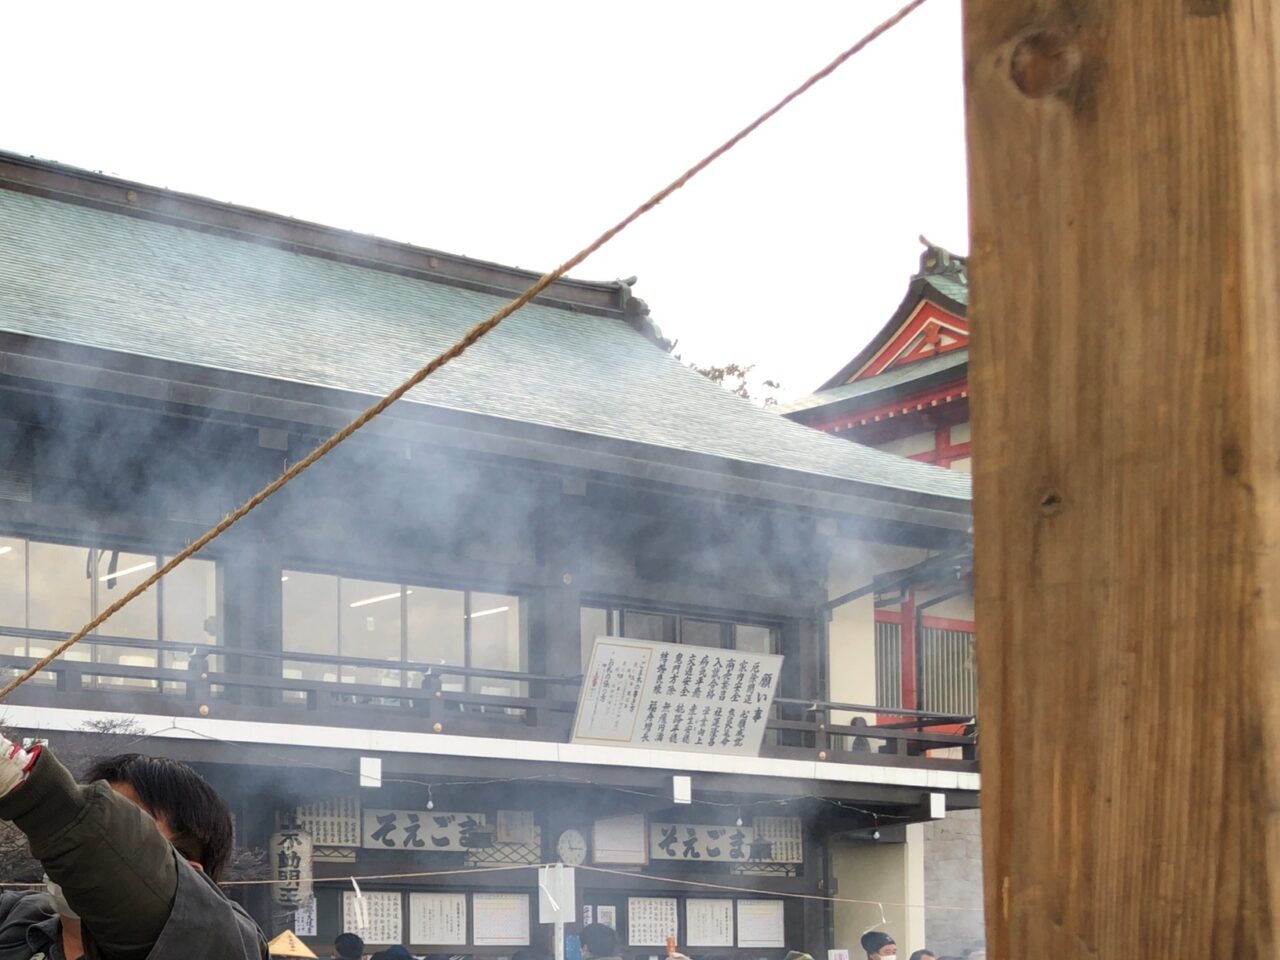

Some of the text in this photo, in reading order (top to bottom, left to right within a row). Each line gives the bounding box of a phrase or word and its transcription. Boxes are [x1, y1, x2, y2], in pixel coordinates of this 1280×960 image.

[680, 653, 697, 697] 交通安全
[732, 659, 748, 702] 家内安全
[752, 672, 772, 723] 願い事
[658, 825, 745, 859] そえごま
[277, 833, 302, 902] 不動明王
